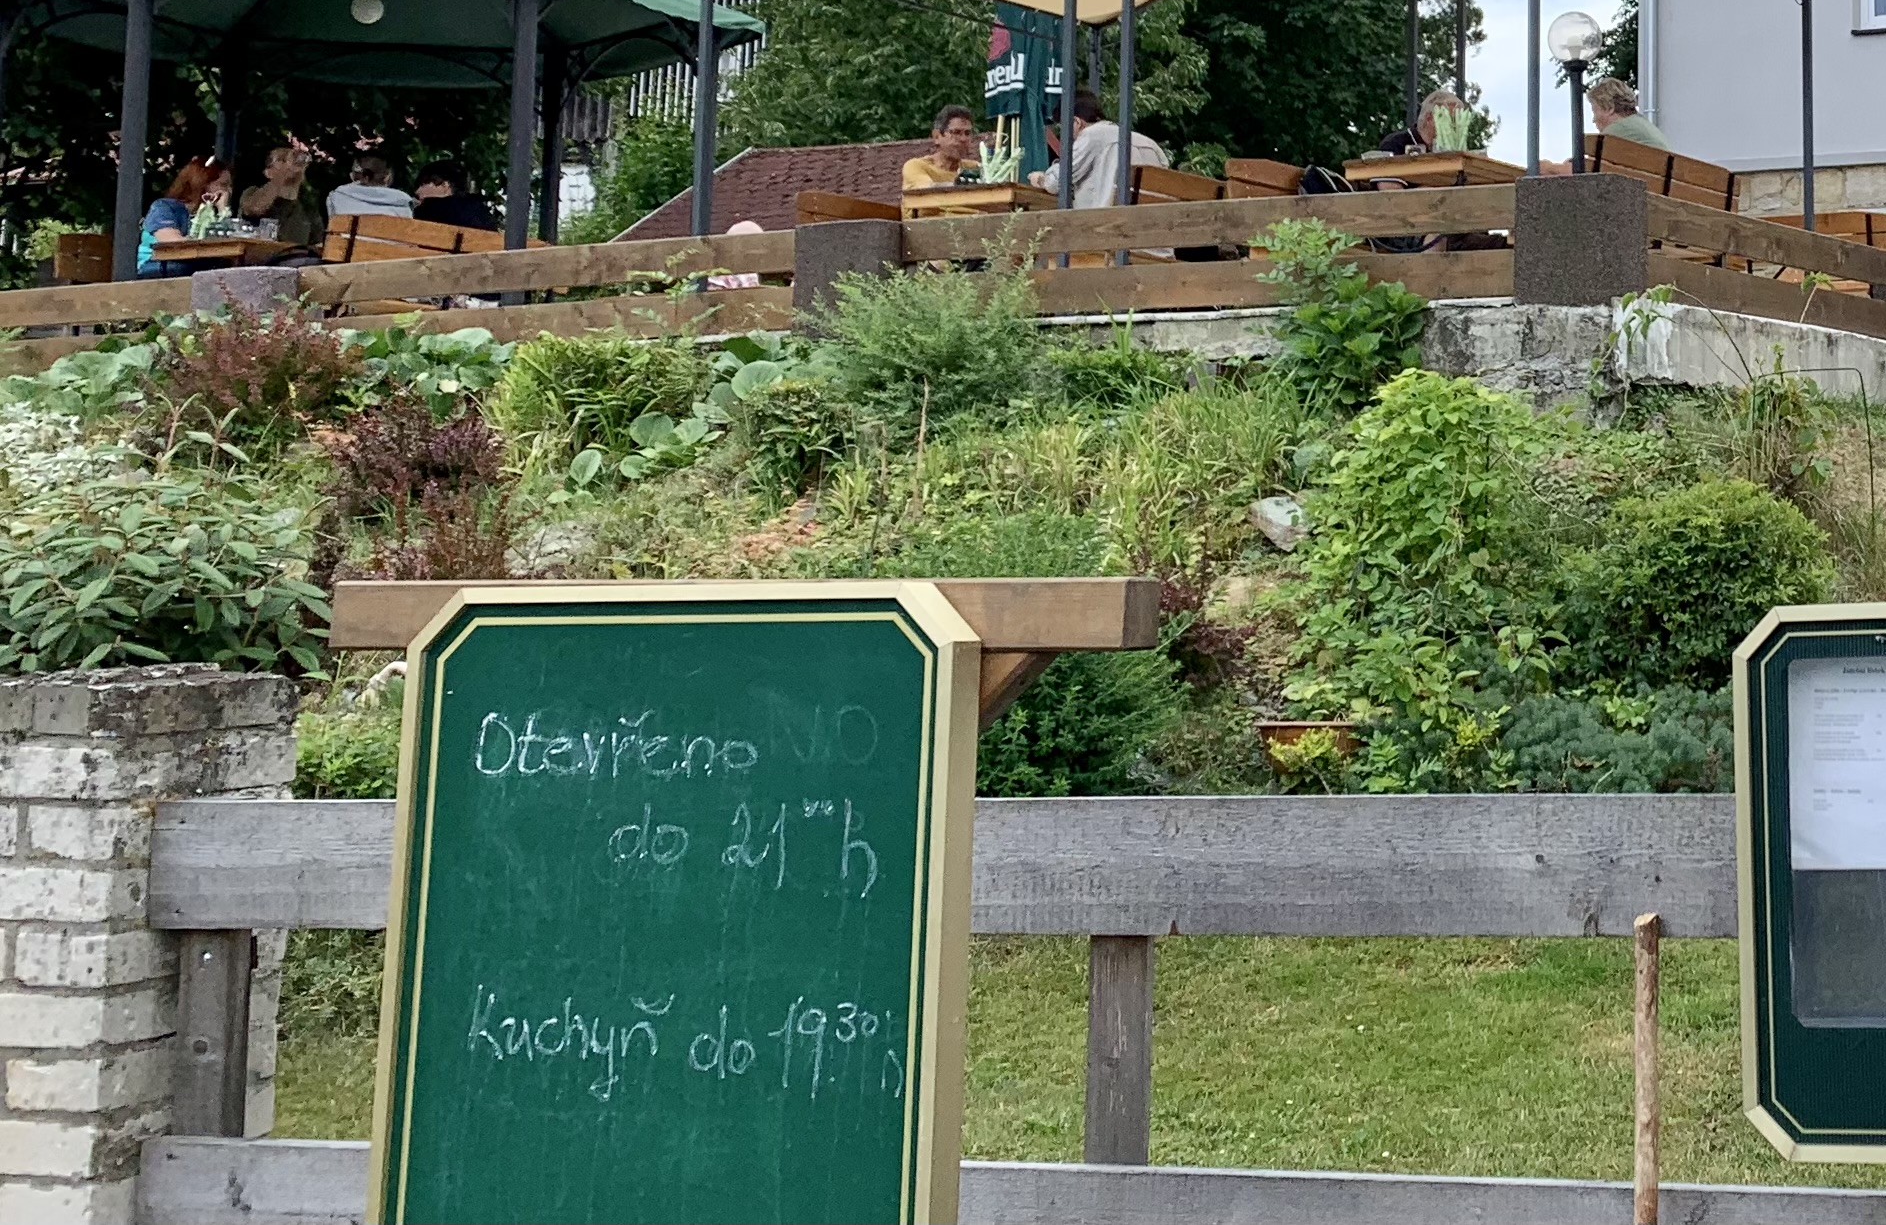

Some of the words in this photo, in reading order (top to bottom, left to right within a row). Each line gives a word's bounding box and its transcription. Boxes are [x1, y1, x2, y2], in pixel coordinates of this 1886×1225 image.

[475, 708, 758, 778] Otevřeno
[608, 802, 690, 865] do
[468, 984, 675, 1102] Kuchyň
[688, 1004, 757, 1081] do
